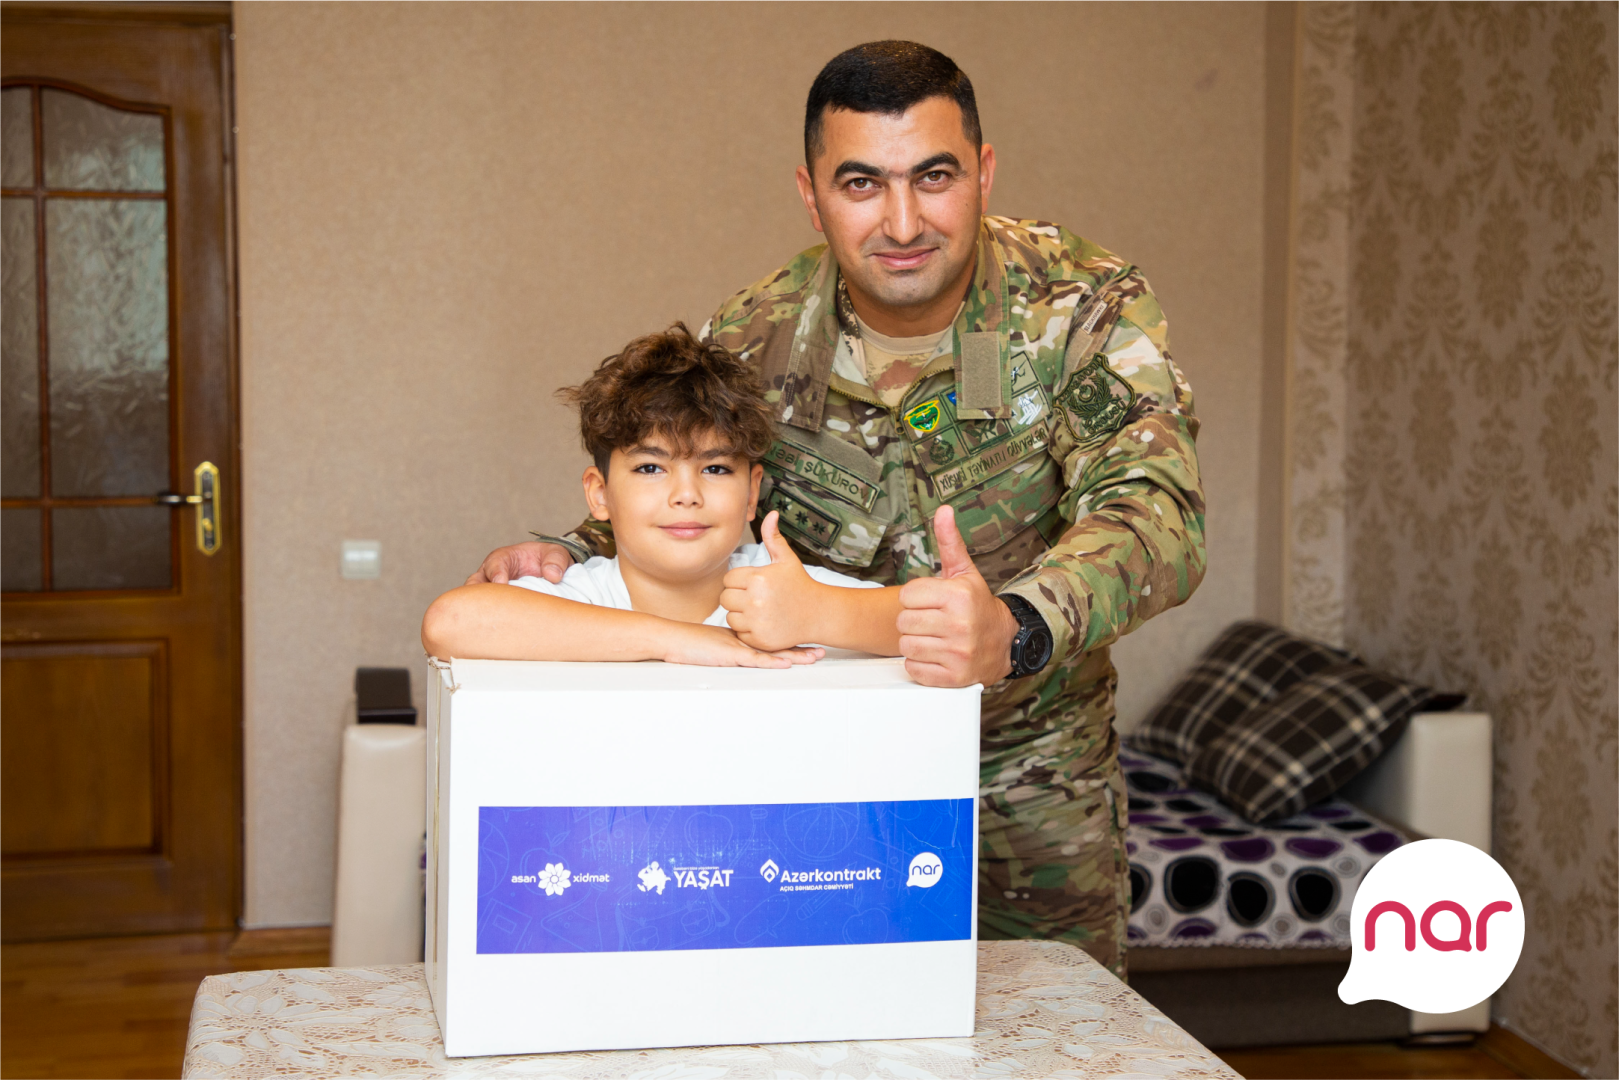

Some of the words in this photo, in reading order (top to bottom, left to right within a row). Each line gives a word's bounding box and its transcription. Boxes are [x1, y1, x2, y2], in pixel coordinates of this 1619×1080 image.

[804, 460, 870, 500] ŞÜKÜROV
[511, 874, 536, 883] asan
[573, 872, 610, 883] xidmət
[780, 867, 881, 883] Azərkontrakt
[911, 864, 941, 876] nar
[673, 869, 734, 890] YAŞAT
